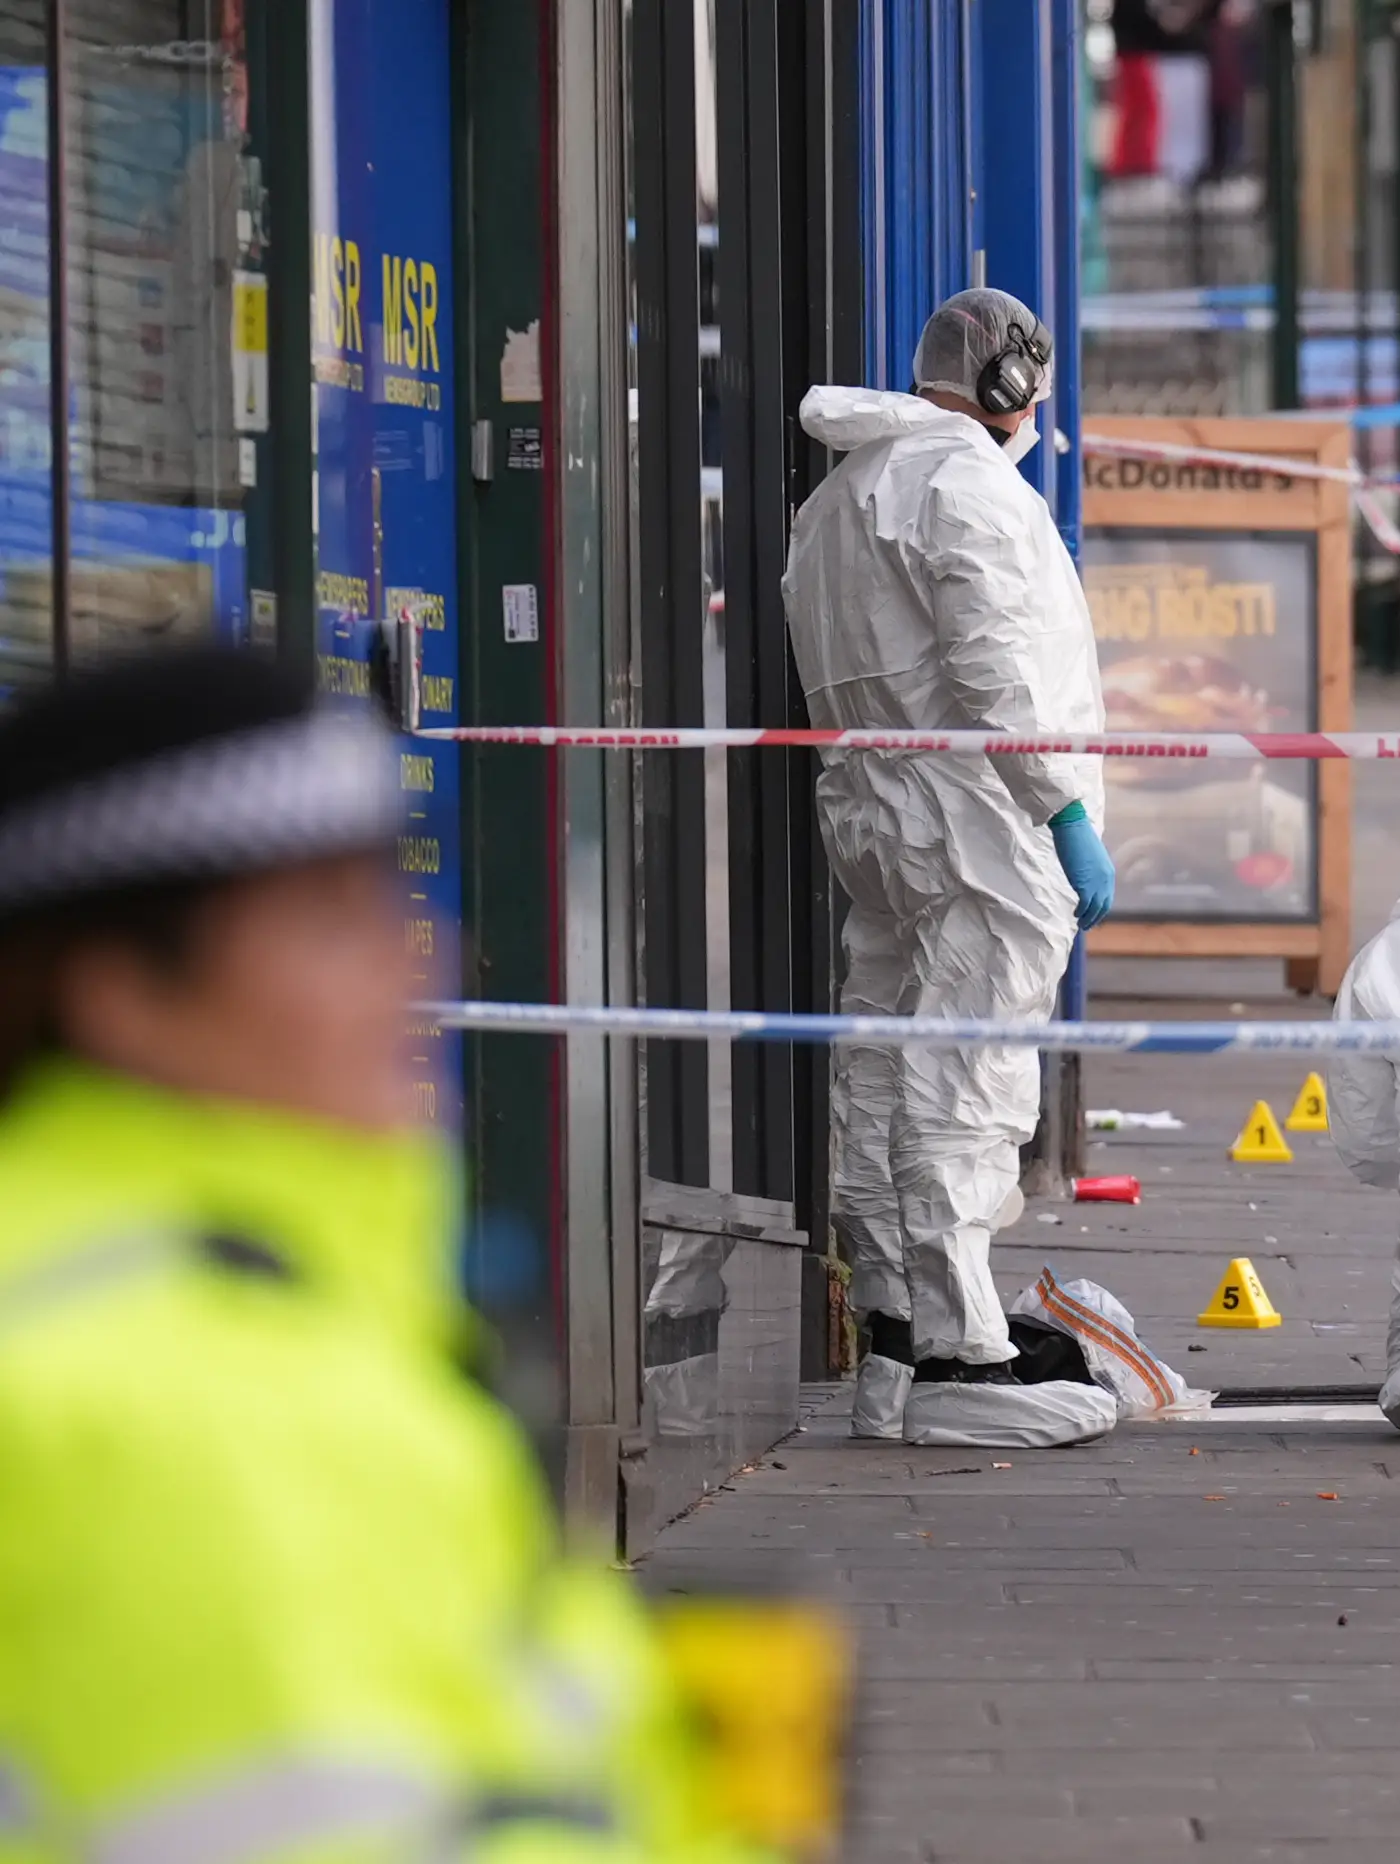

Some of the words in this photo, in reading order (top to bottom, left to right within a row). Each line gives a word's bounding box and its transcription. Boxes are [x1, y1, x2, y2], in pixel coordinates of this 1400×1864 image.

[313, 232, 363, 353] MSR
[382, 253, 439, 372] MSR
[1083, 456, 1293, 491] cDonalds
[397, 836, 440, 874] TOBACCO
[1306, 1095, 1320, 1116] 3
[1256, 1124, 1265, 1146] 1
[1222, 1285, 1240, 1310] 5
